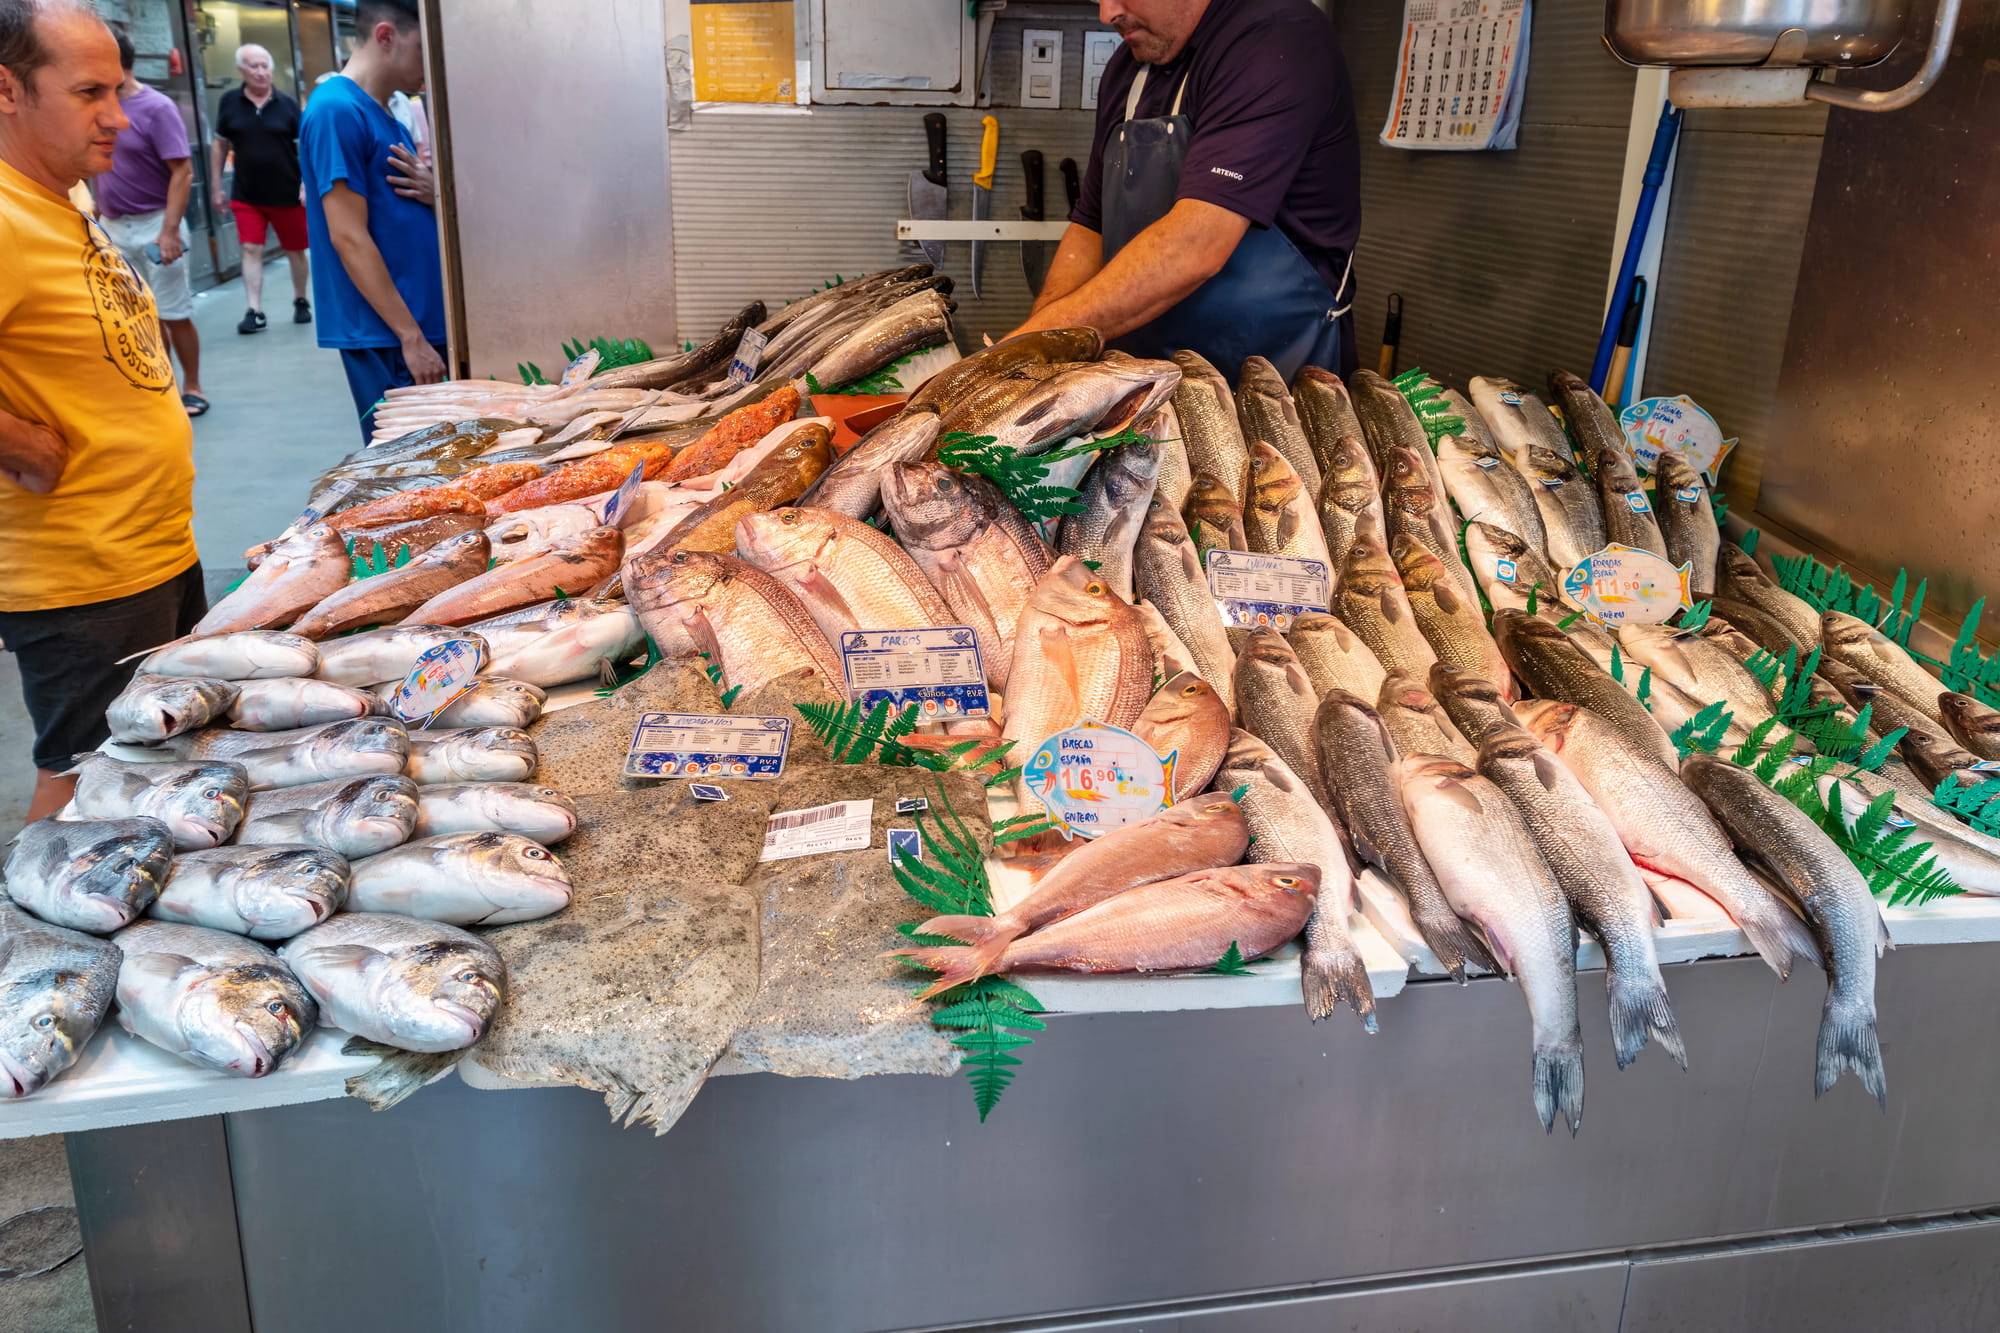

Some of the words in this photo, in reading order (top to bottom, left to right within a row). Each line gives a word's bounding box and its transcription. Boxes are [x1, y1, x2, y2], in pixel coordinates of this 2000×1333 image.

[1413, 31, 1419, 48] 1
[1431, 29, 1437, 47] 2
[1447, 28, 1453, 46] 3
[1463, 26, 1469, 44] 4
[1476, 24, 1482, 43] 5
[1491, 22, 1498, 41] 6
[1506, 19, 1513, 39] 7
[1410, 53, 1416, 71] 8
[1428, 52, 1434, 70] 9
[1443, 51, 1452, 69] 10
[1459, 49, 1468, 68] 11
[1471, 48, 1480, 67] 12
[1486, 46, 1494, 66] 13
[1501, 45, 1510, 65] 14
[1406, 75, 1415, 94] 15
[1423, 75, 1432, 93] 16
[1440, 74, 1449, 93] 17
[1455, 73, 1464, 92] 18
[1469, 72, 1477, 92] 19
[1482, 71, 1492, 90] 20
[1497, 70, 1506, 89] 21
[1401, 98, 1412, 116] 22
[1419, 98, 1429, 116] 23
[1436, 98, 1446, 116] 24
[1451, 97, 1461, 115] 25
[1464, 96, 1474, 115] 26
[1479, 95, 1488, 115] 27
[1396, 120, 1408, 138] 29
[1416, 120, 1426, 138] 30
[1433, 120, 1442, 138] 31
[1211, 166, 1243, 180] ARTENGO
[1060, 754, 1092, 765] ESPAÑA
[1064, 812, 1099, 824] ENTEROS
